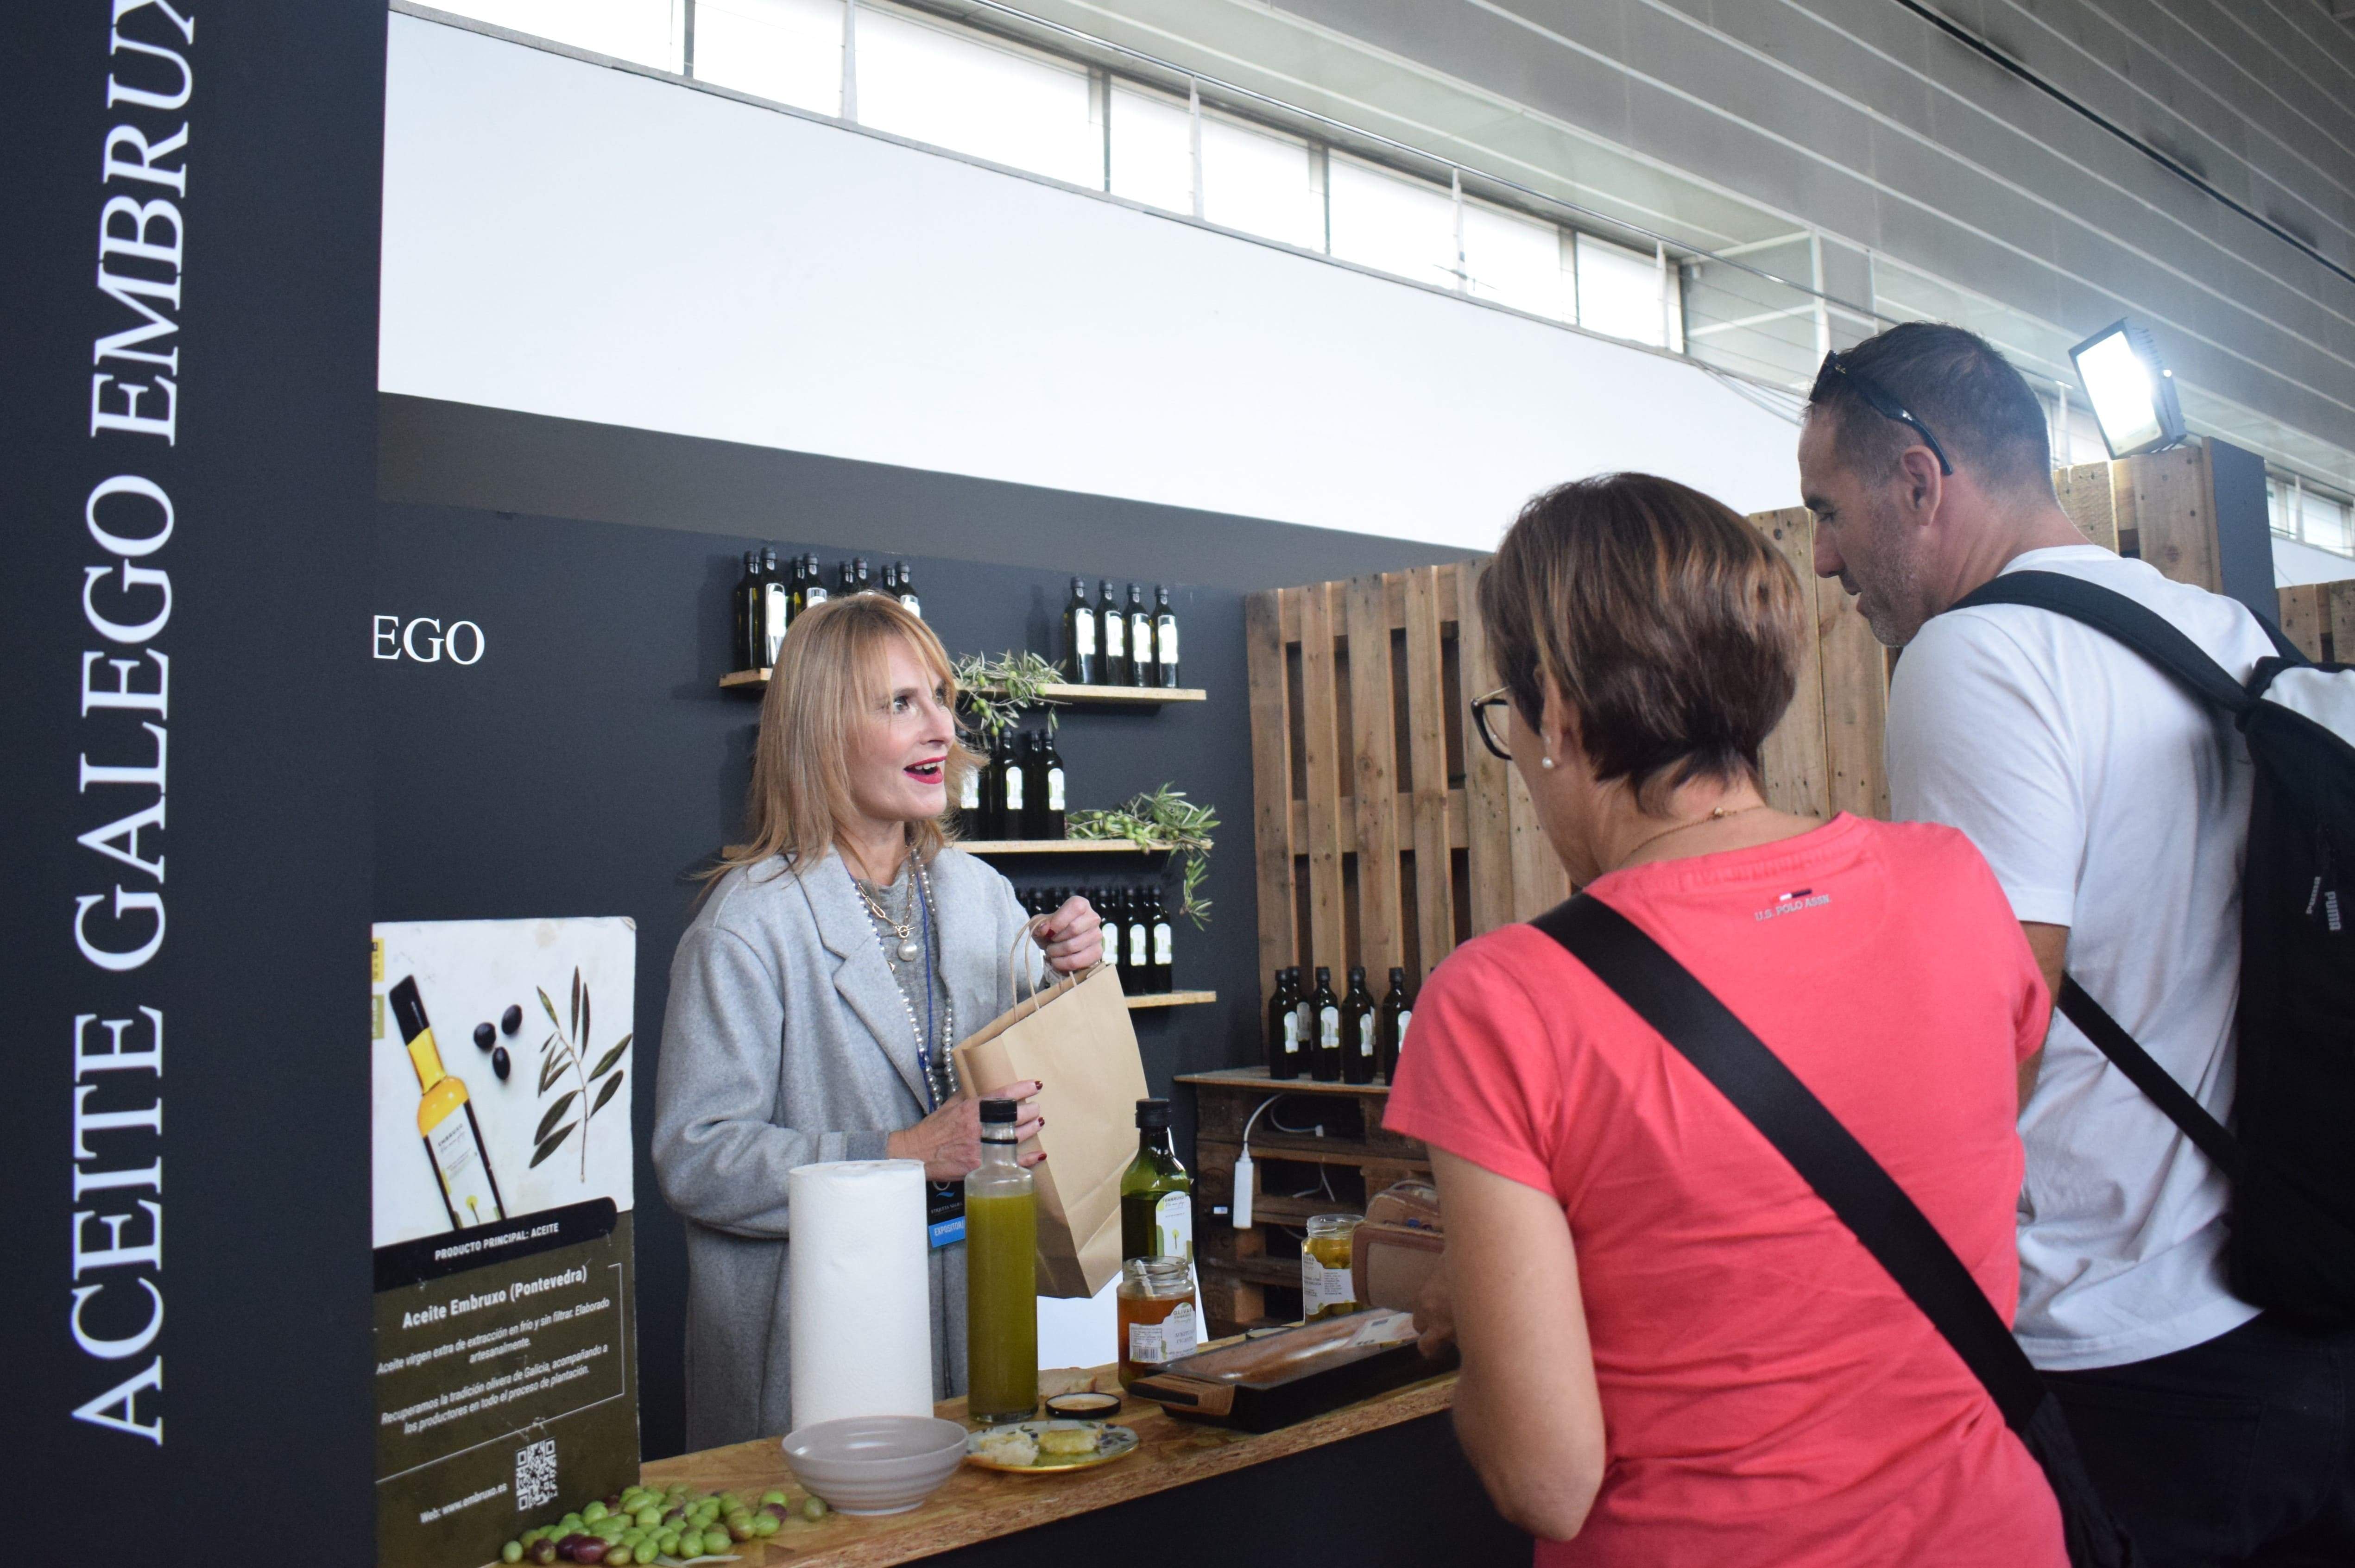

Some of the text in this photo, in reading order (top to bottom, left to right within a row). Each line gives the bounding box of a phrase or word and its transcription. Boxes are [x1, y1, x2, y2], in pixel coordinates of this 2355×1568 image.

[74, 475, 175, 970] GALEGO
[1776, 900, 1803, 916] POLO
[70, 1005, 164, 1446] ACEITE
[435, 1222, 559, 1260] PRODUCTO PRINCIPAL: ACEITE
[403, 1265, 587, 1329] Aceite Embruxo (Pontevedra)
[376, 1297, 610, 1375] Aceite virgen extra de extracción en frío y sin filtrar. Elaborado
[469, 1337, 531, 1363] artesanalmente.
[381, 1344, 608, 1425] Recuperamos la tradición olivera de Galicia, acompañando a
[404, 1364, 589, 1434] los productores en todo el proceso de plantación.
[420, 1483, 507, 1524] Web: www.embruxo.es
